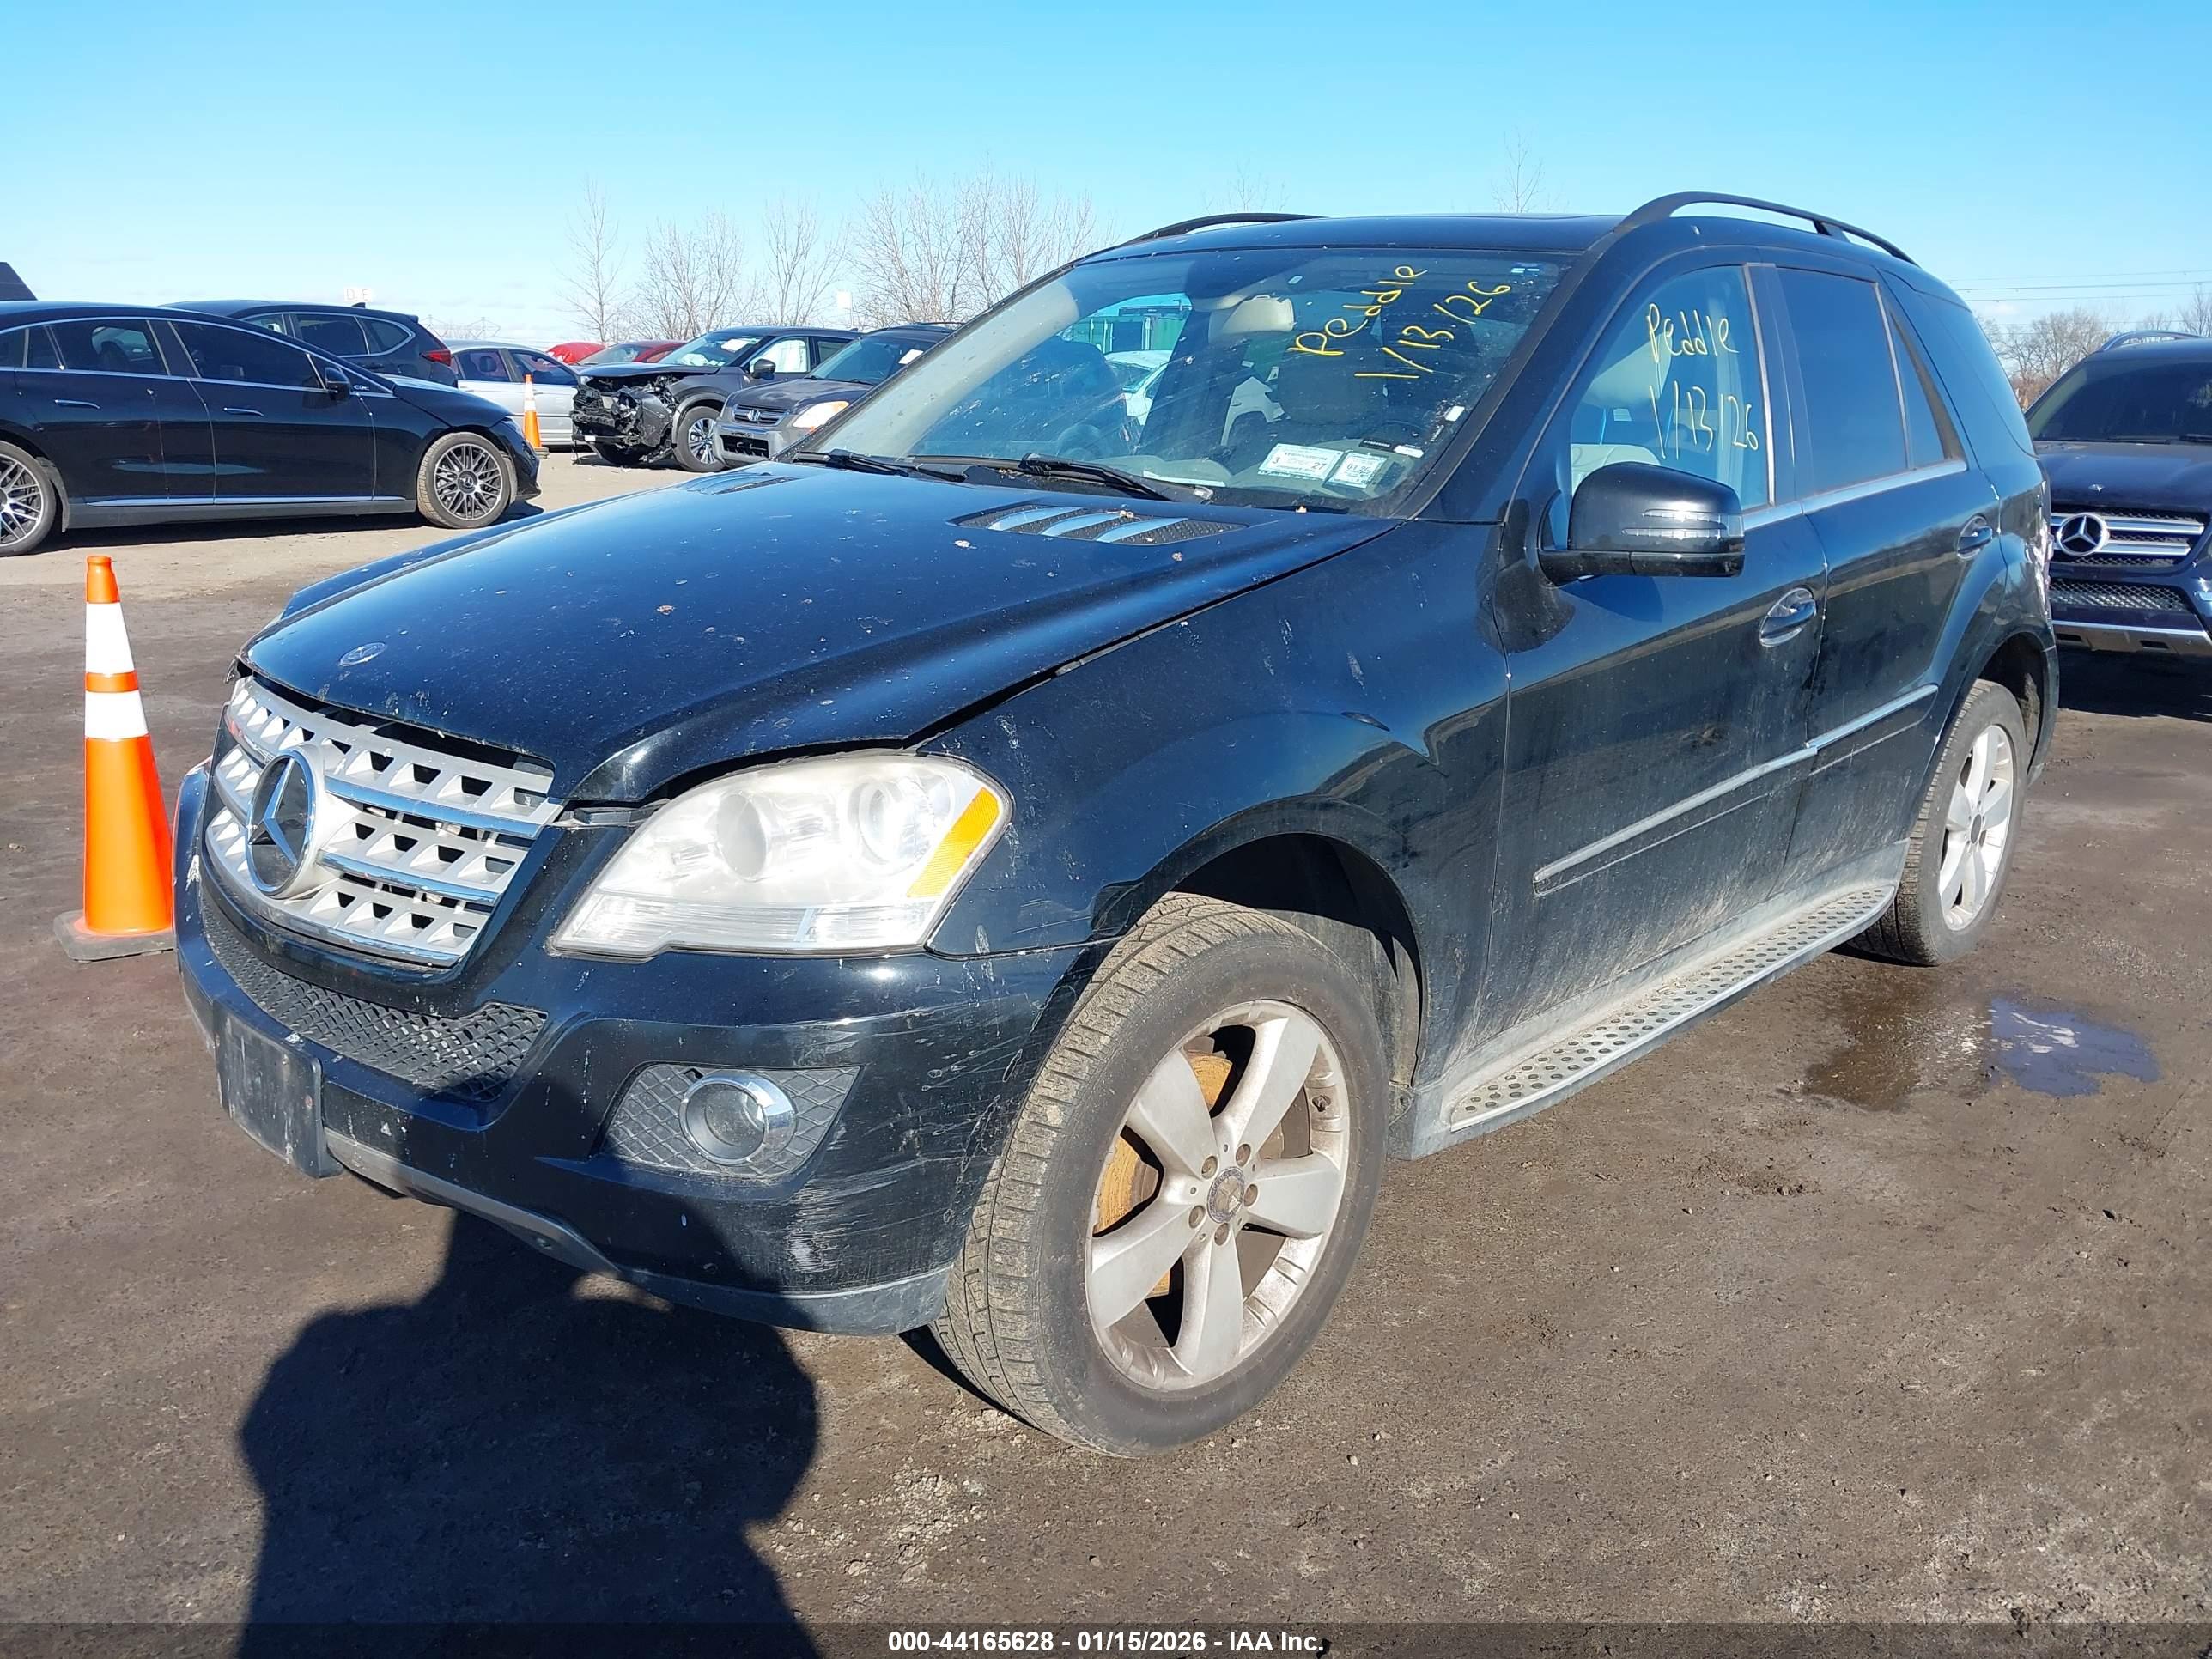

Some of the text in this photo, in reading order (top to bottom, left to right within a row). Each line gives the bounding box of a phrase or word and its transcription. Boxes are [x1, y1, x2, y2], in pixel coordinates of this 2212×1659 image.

[1646, 302, 1740, 364] Peddle
[1649, 380, 1759, 460] 1/13/26
[1311, 461, 1327, 471] 27
